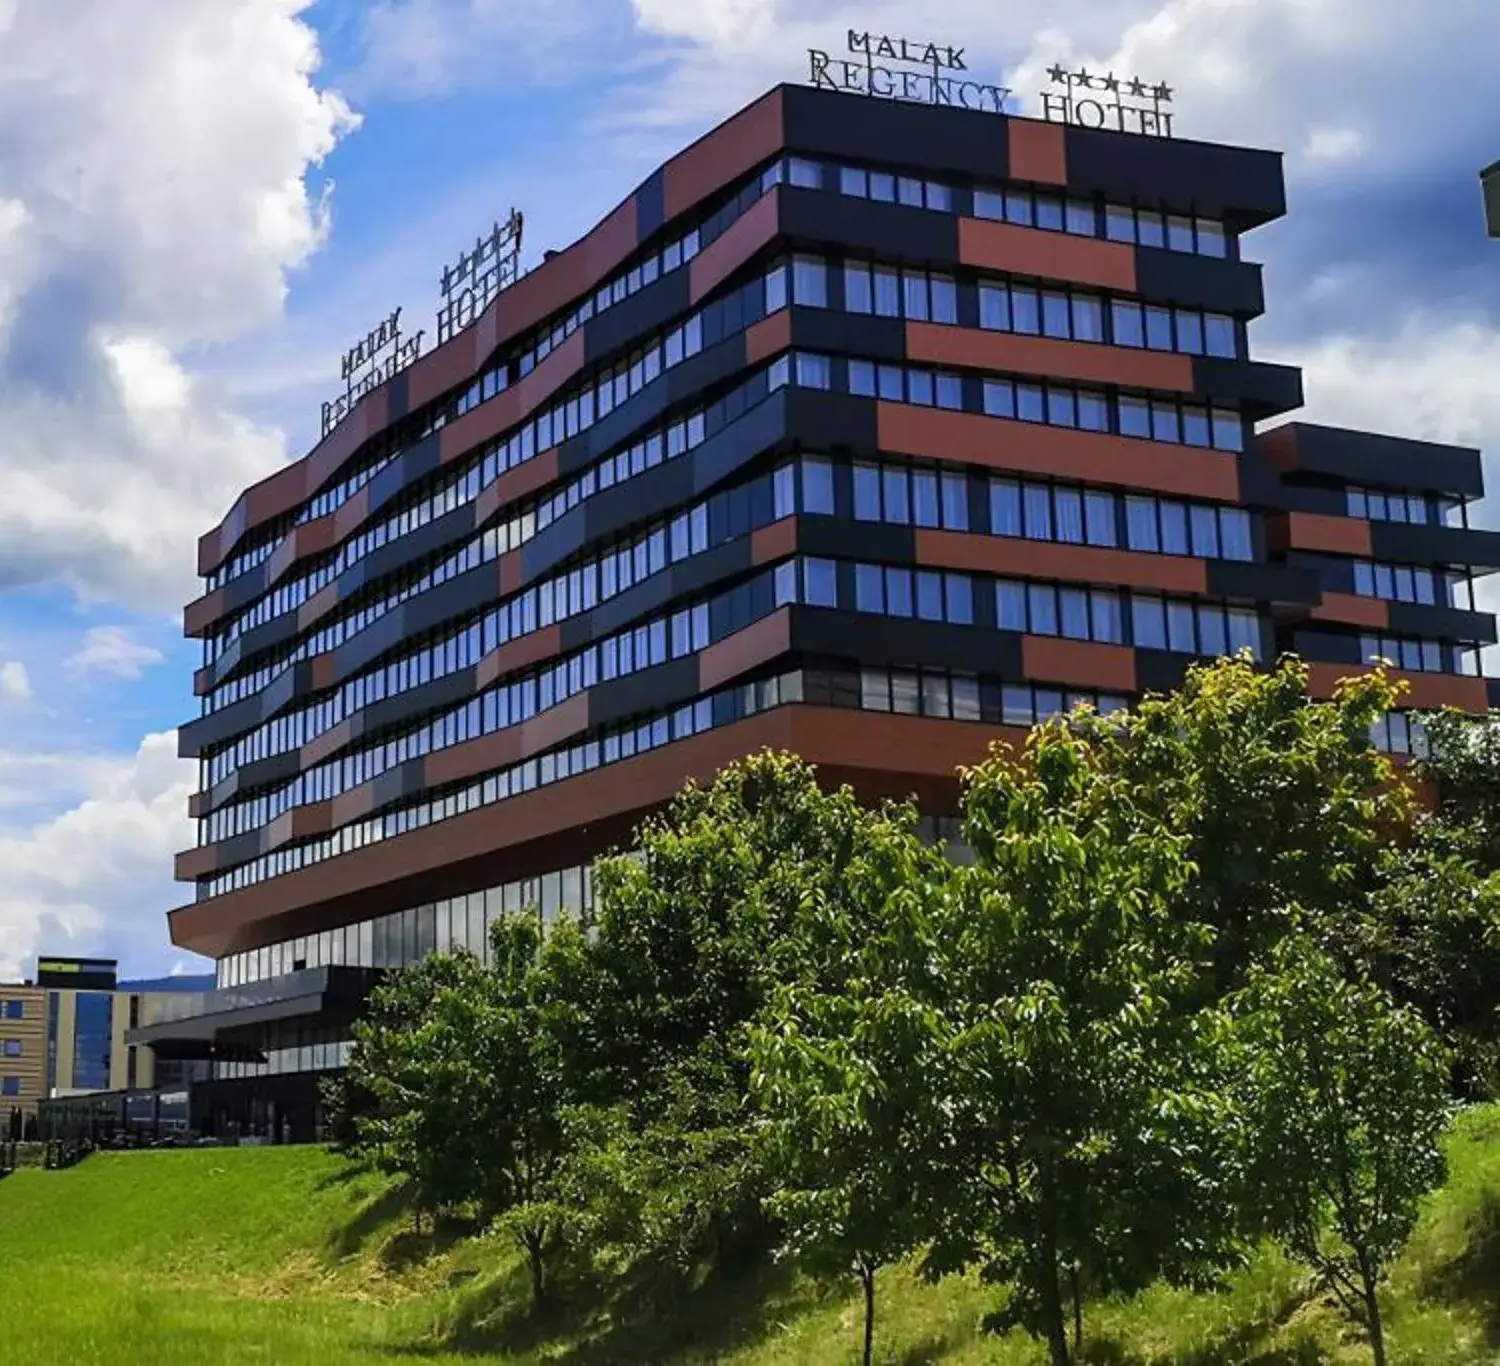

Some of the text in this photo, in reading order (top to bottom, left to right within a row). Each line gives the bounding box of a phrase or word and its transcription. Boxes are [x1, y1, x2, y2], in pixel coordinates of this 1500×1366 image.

[848, 29, 967, 70] MALAK
[807, 48, 1174, 138] REGENCY HOTEL
